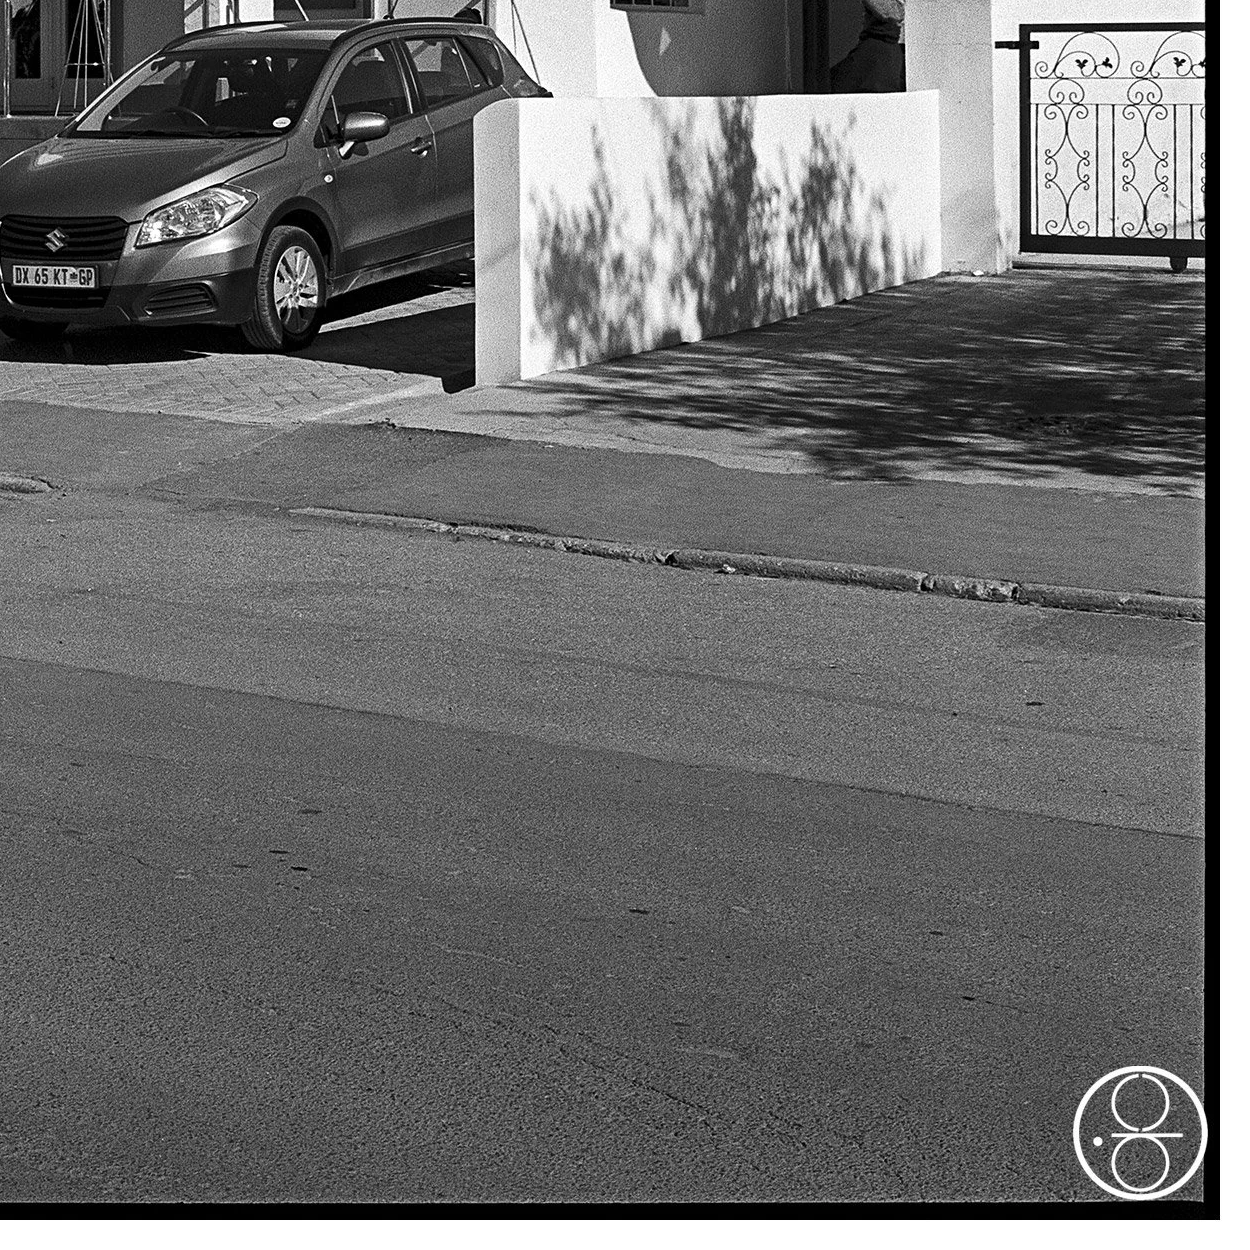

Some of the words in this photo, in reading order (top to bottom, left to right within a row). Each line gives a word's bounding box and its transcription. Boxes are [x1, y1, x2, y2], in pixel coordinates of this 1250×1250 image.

[15, 267, 29, 284] DX
[34, 268, 48, 285] 65
[53, 268, 68, 285] KT
[78, 269, 93, 286] GP
